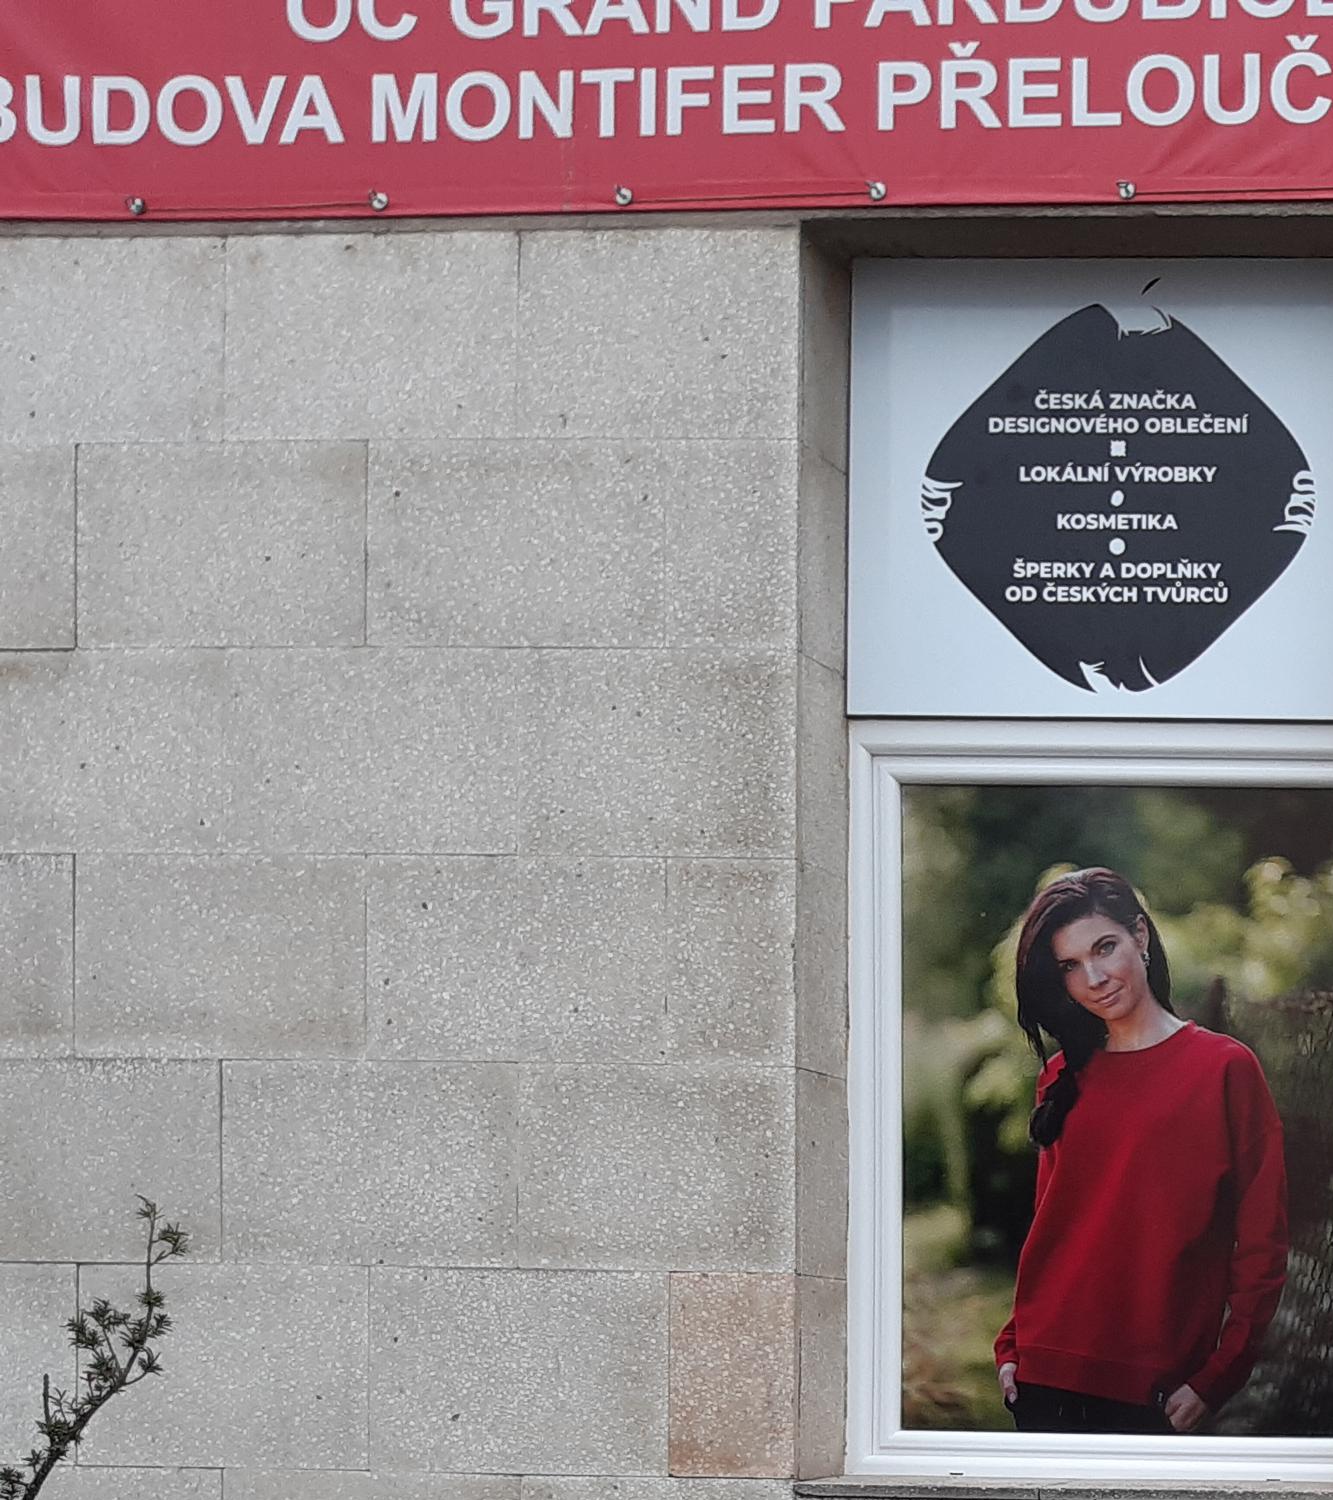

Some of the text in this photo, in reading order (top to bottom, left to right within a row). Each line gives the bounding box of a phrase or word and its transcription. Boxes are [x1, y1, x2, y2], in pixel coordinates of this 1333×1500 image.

[286, 0, 418, 42] OC
[371, 64, 846, 143] MONTIFER
[877, 35, 1332, 132] PŘELOUČ
[1034, 389, 1197, 410] ČESKÁ ZNAČKA
[988, 413, 1249, 434] DESIGNOVÉHO OBLEČENÍ
[1019, 462, 1217, 483] LOKÁLNÍ VÝROBKY
[1056, 513, 1178, 530] KOSMETIKA
[1013, 558, 1222, 579] ŠPERKY A DOPLŇKY
[1005, 580, 1229, 603] OD ČESKÝCH TVŮRCŮ
